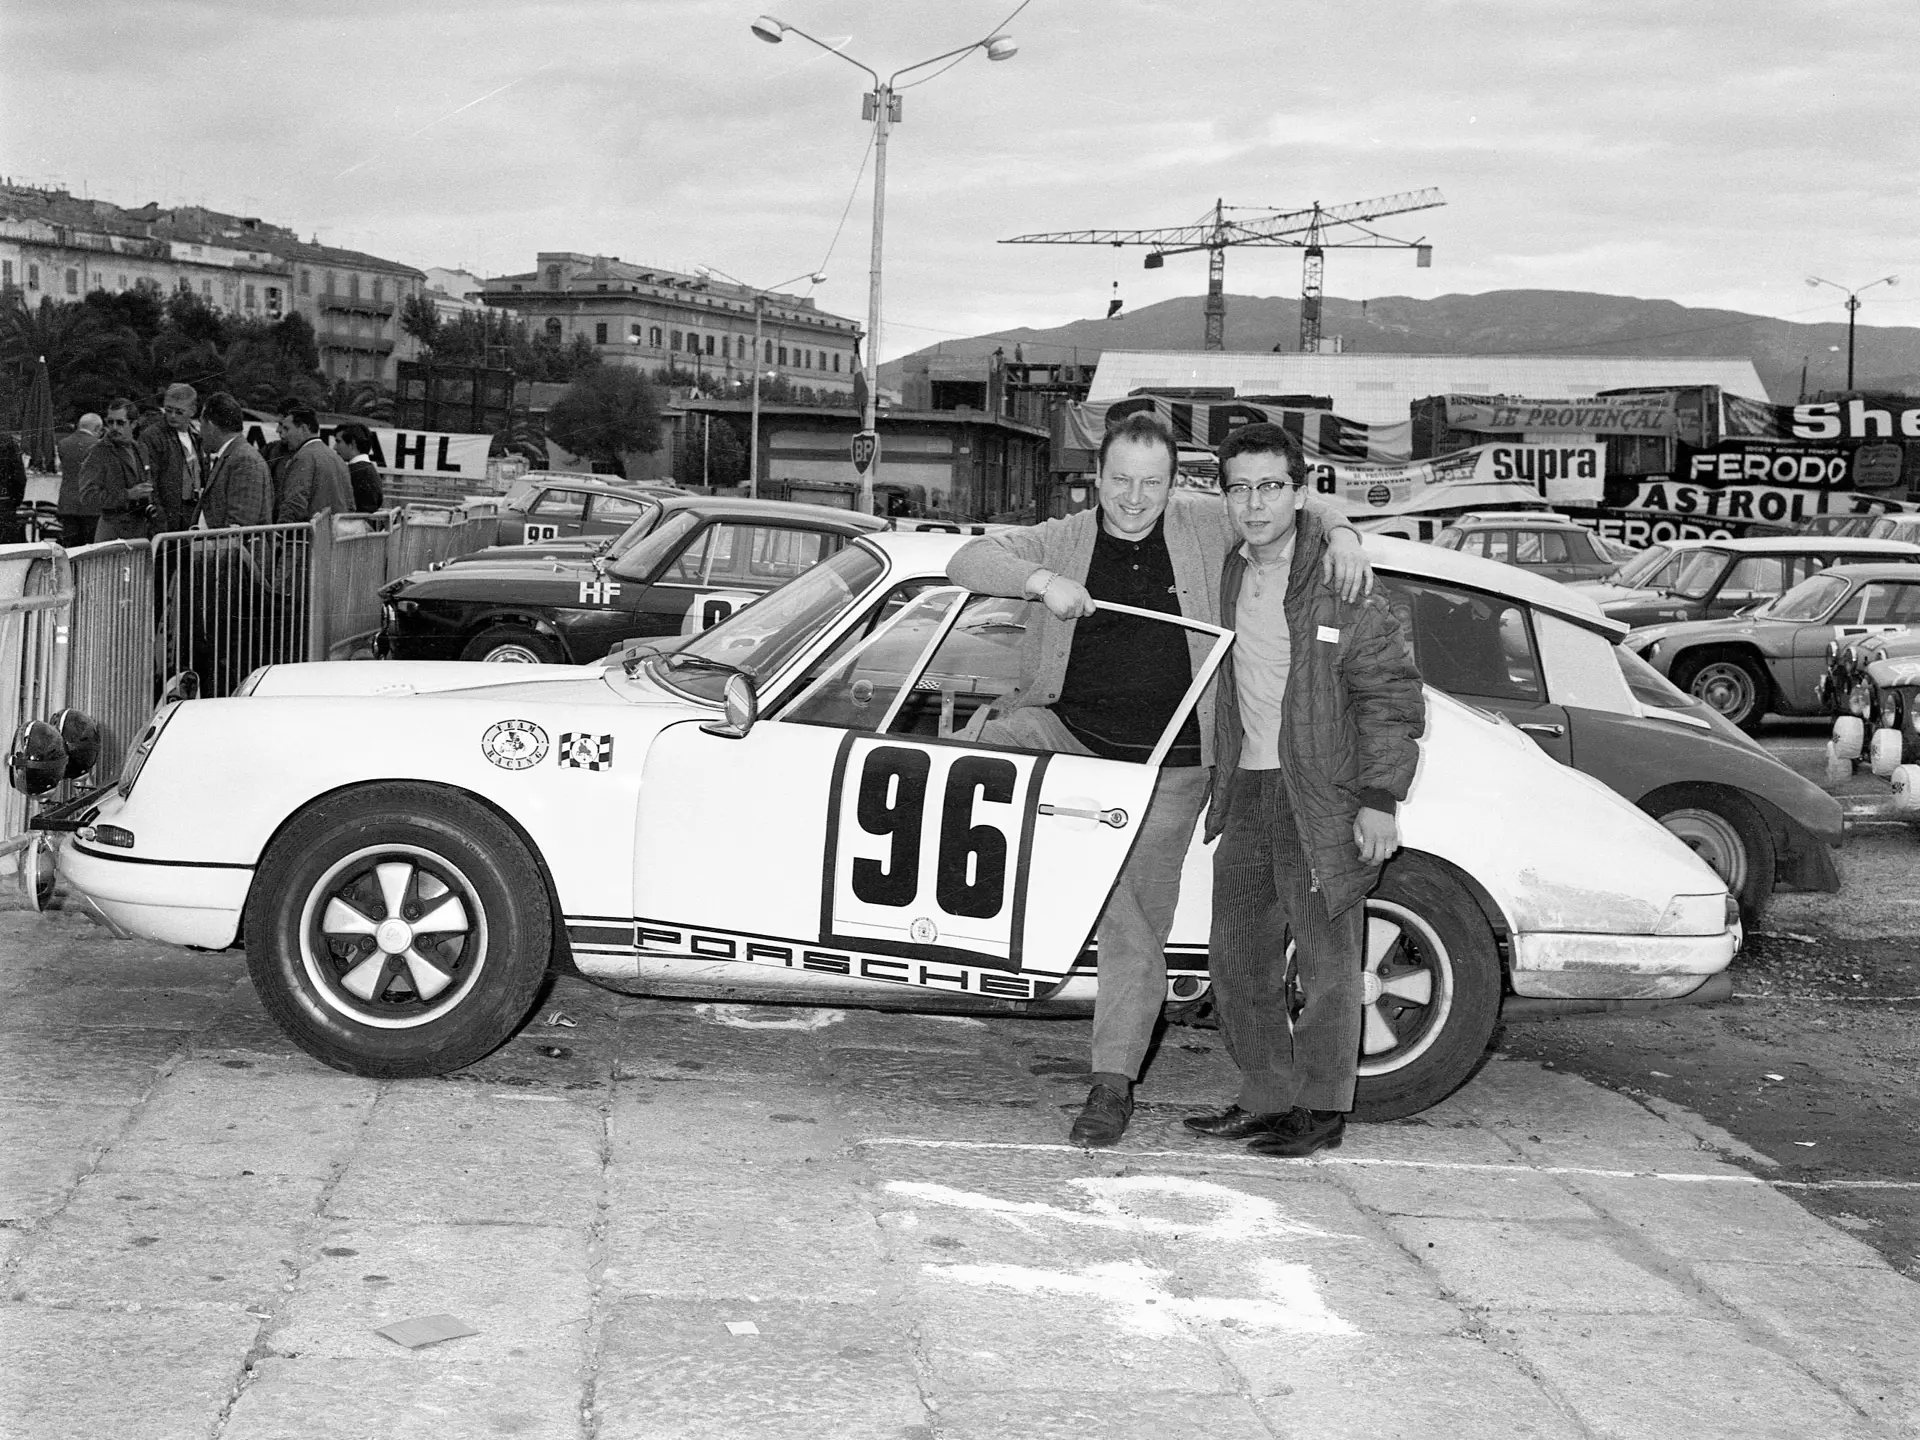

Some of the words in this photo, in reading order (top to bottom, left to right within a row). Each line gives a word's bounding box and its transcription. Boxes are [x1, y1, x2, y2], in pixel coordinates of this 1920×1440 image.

[1490, 408, 1521, 428] LE
[1525, 408, 1665, 432] PROVENÇAL
[855, 439, 874, 462] BP
[1493, 448, 1597, 498] supra
[1690, 453, 1847, 484] FERODO
[579, 581, 620, 604] HF
[497, 722, 536, 732] TEAM
[852, 745, 1017, 920] 96
[637, 926, 1030, 998] PORSCHE
